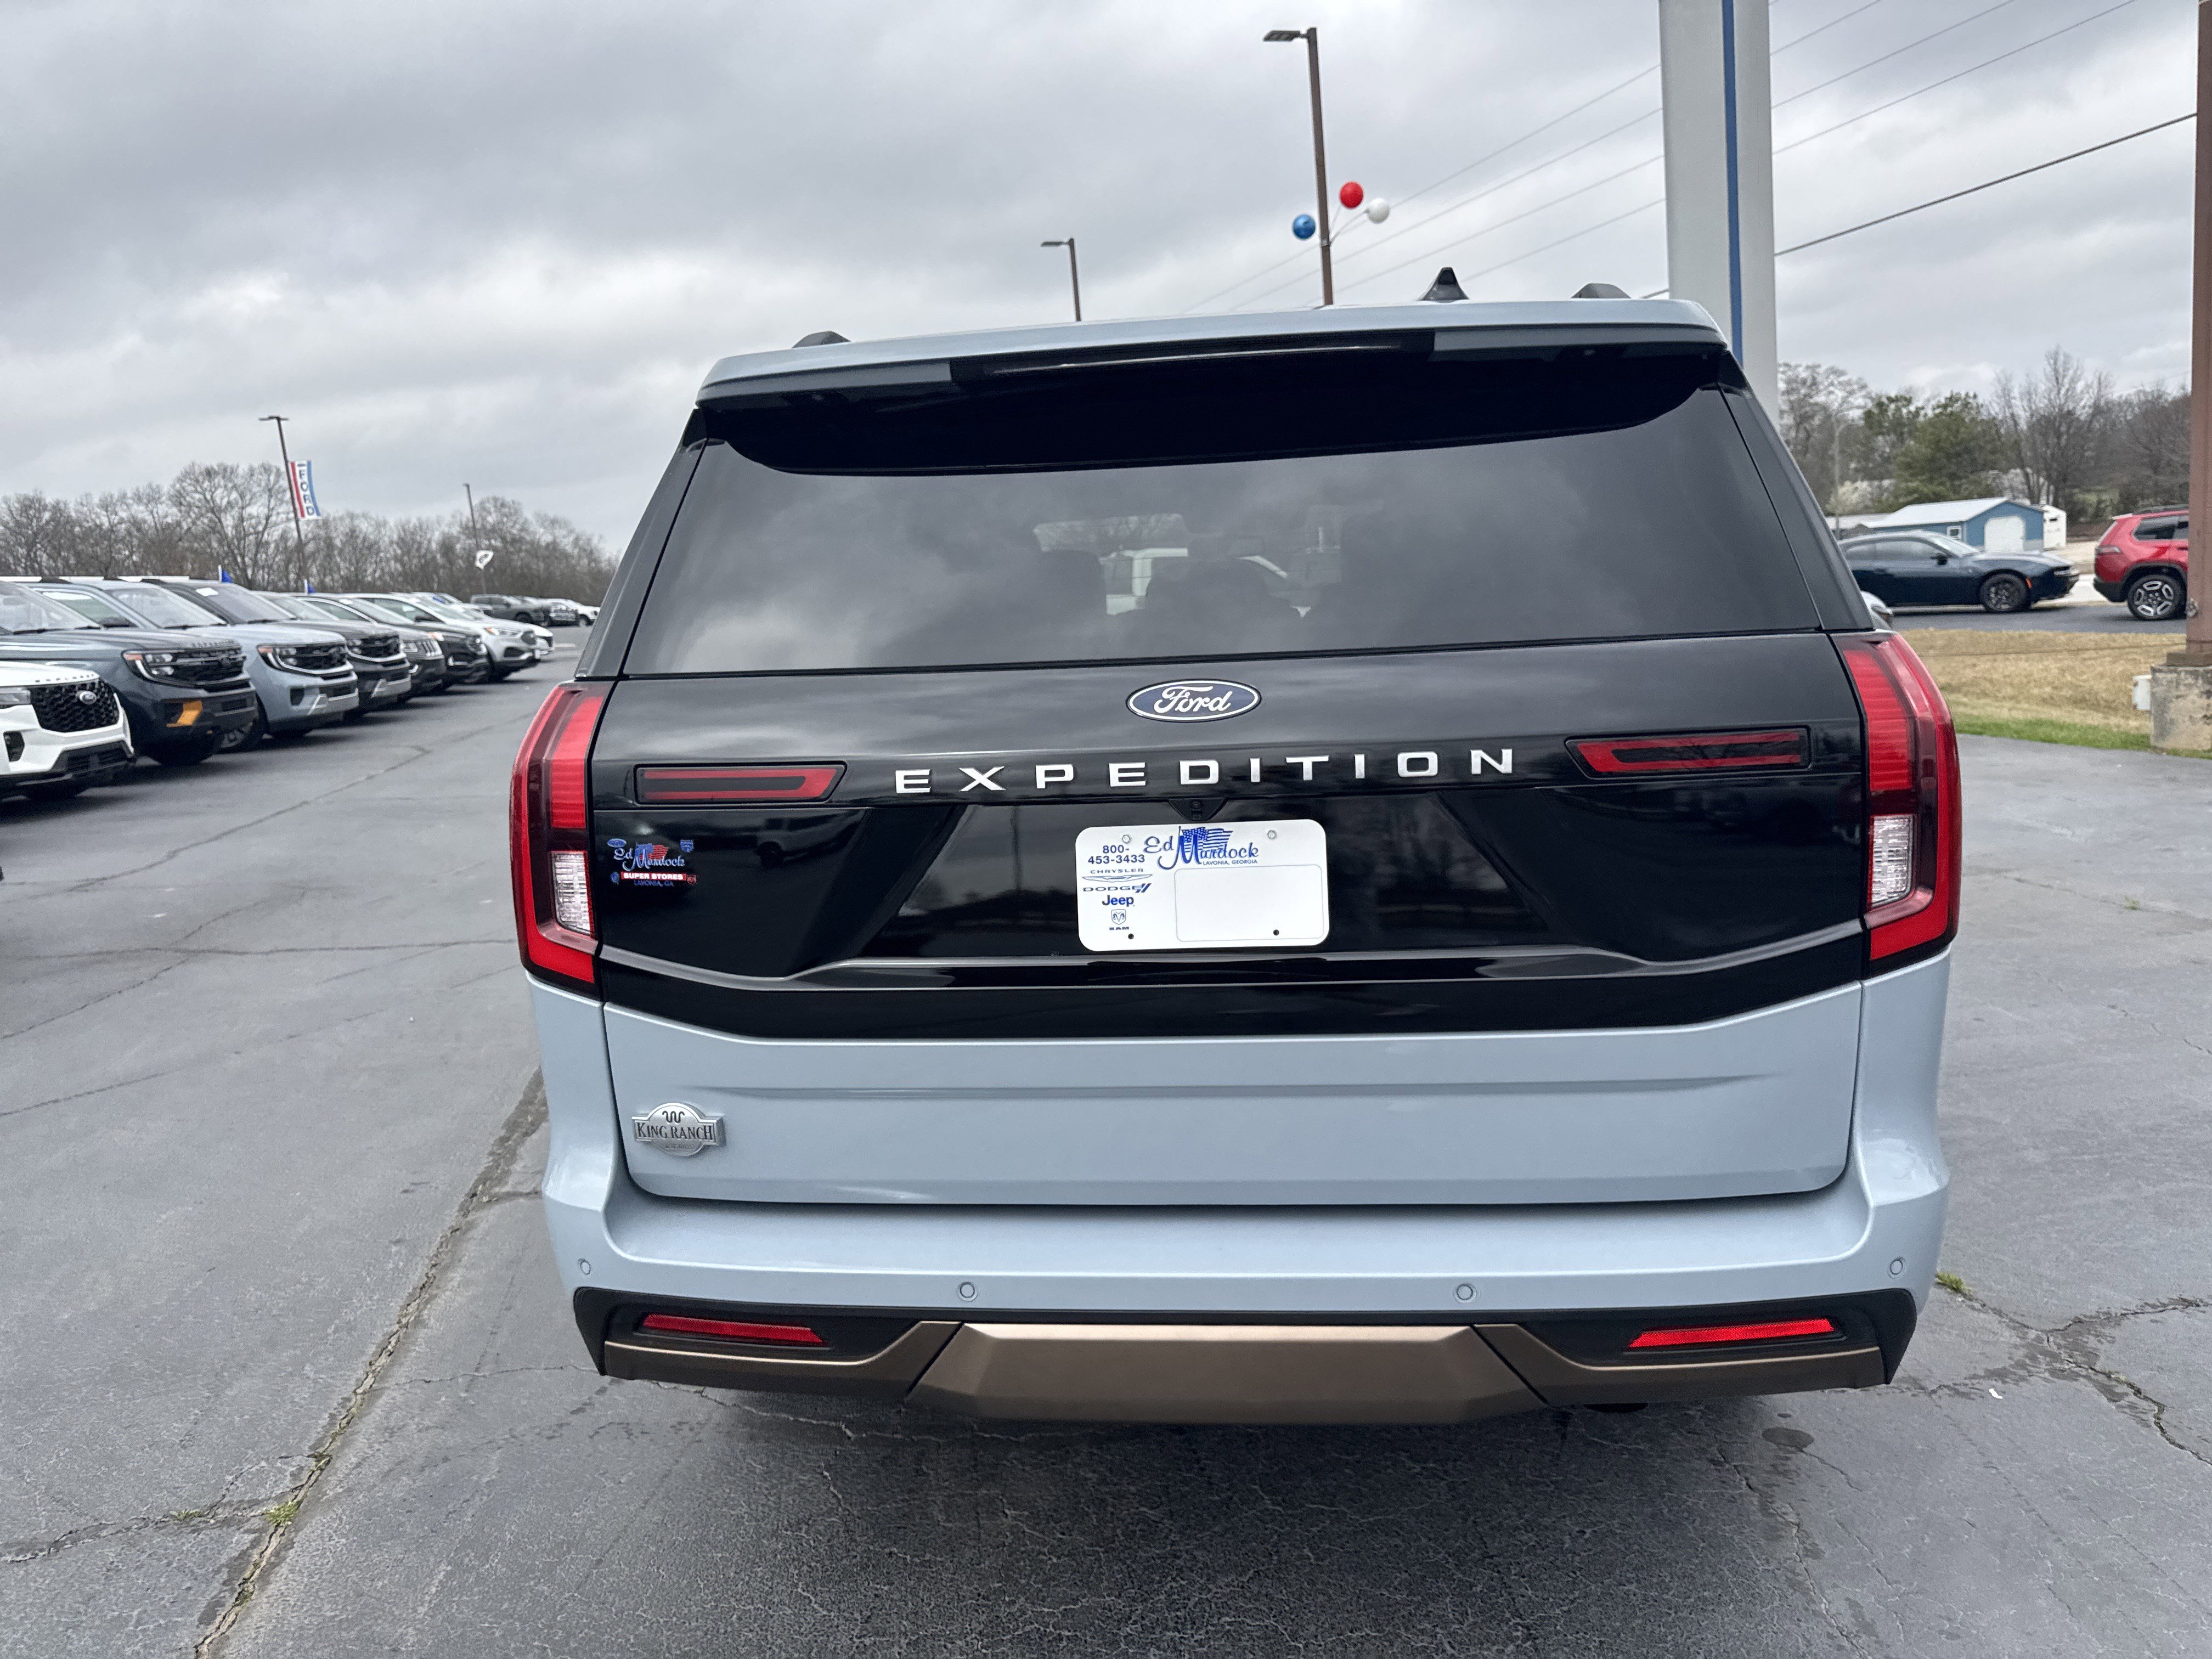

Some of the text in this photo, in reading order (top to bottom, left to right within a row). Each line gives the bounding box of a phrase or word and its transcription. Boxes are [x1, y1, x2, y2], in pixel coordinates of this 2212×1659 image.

[299, 469, 314, 516] FORD
[1154, 686, 1233, 713] Ford
[895, 748, 1513, 794] EXPEDITION
[1088, 854, 1145, 865] 453-3433
[1103, 845, 1130, 854] 800-
[1143, 833, 1259, 870] Ed Murdock
[1102, 895, 1134, 907] Jeep
[637, 1122, 713, 1140] KING RANCH
